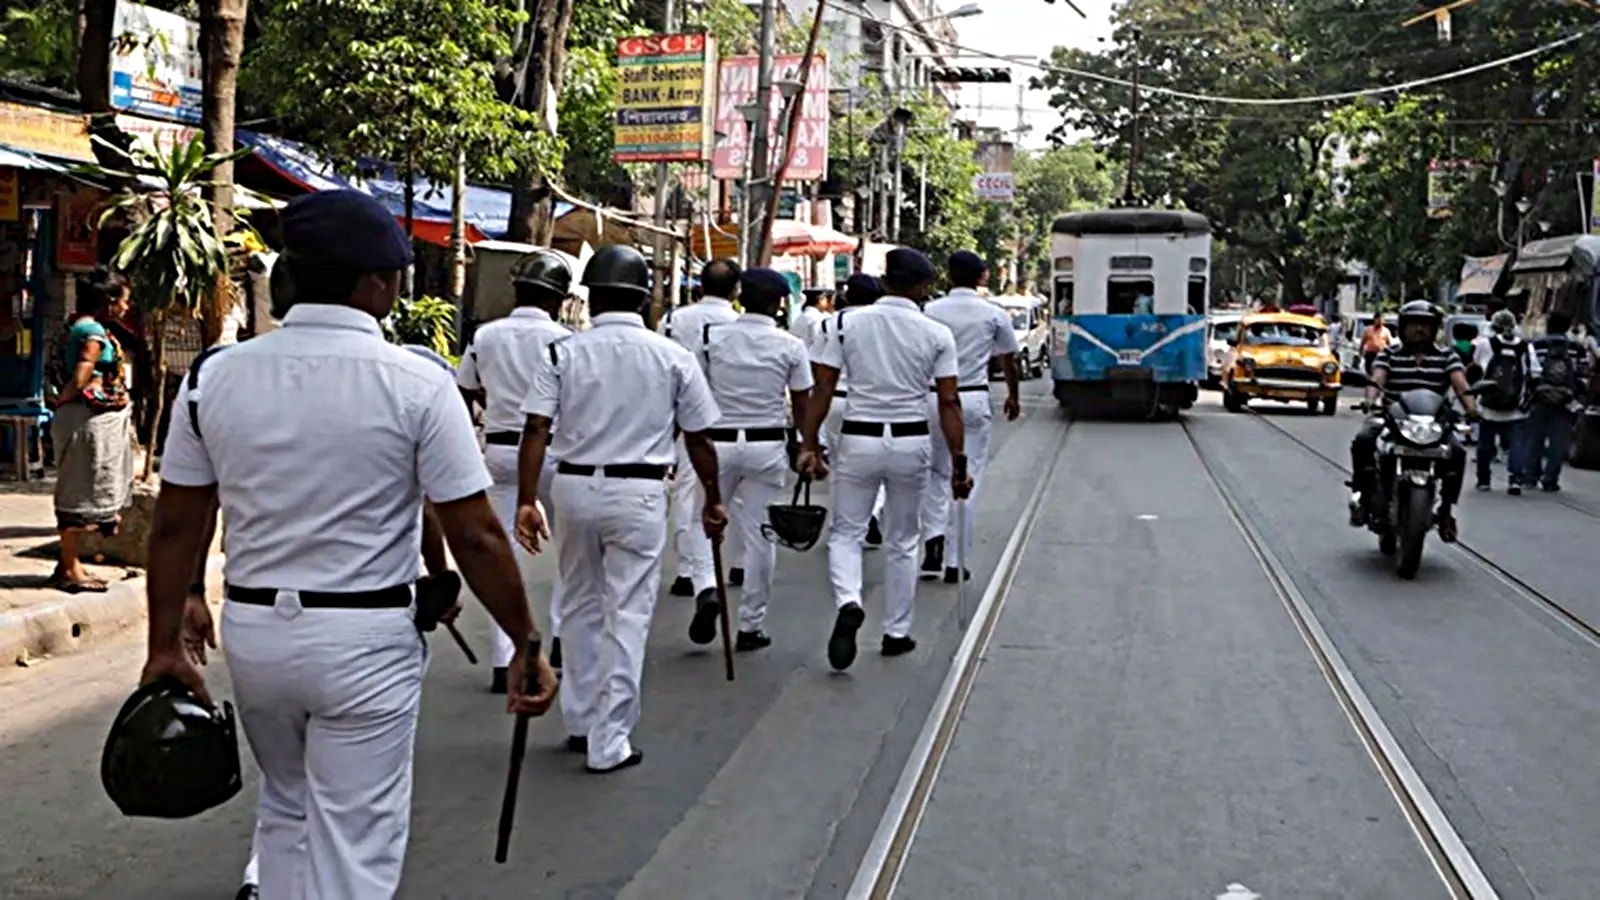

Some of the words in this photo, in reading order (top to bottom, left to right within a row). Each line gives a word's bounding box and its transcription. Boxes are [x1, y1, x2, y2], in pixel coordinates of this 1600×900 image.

[619, 33, 703, 55] GSCE
[623, 66, 650, 83] Staff
[652, 64, 704, 82] Selection
[623, 88, 660, 104] BANK
[667, 86, 703, 105] Army
[978, 177, 1011, 189] CECIL
